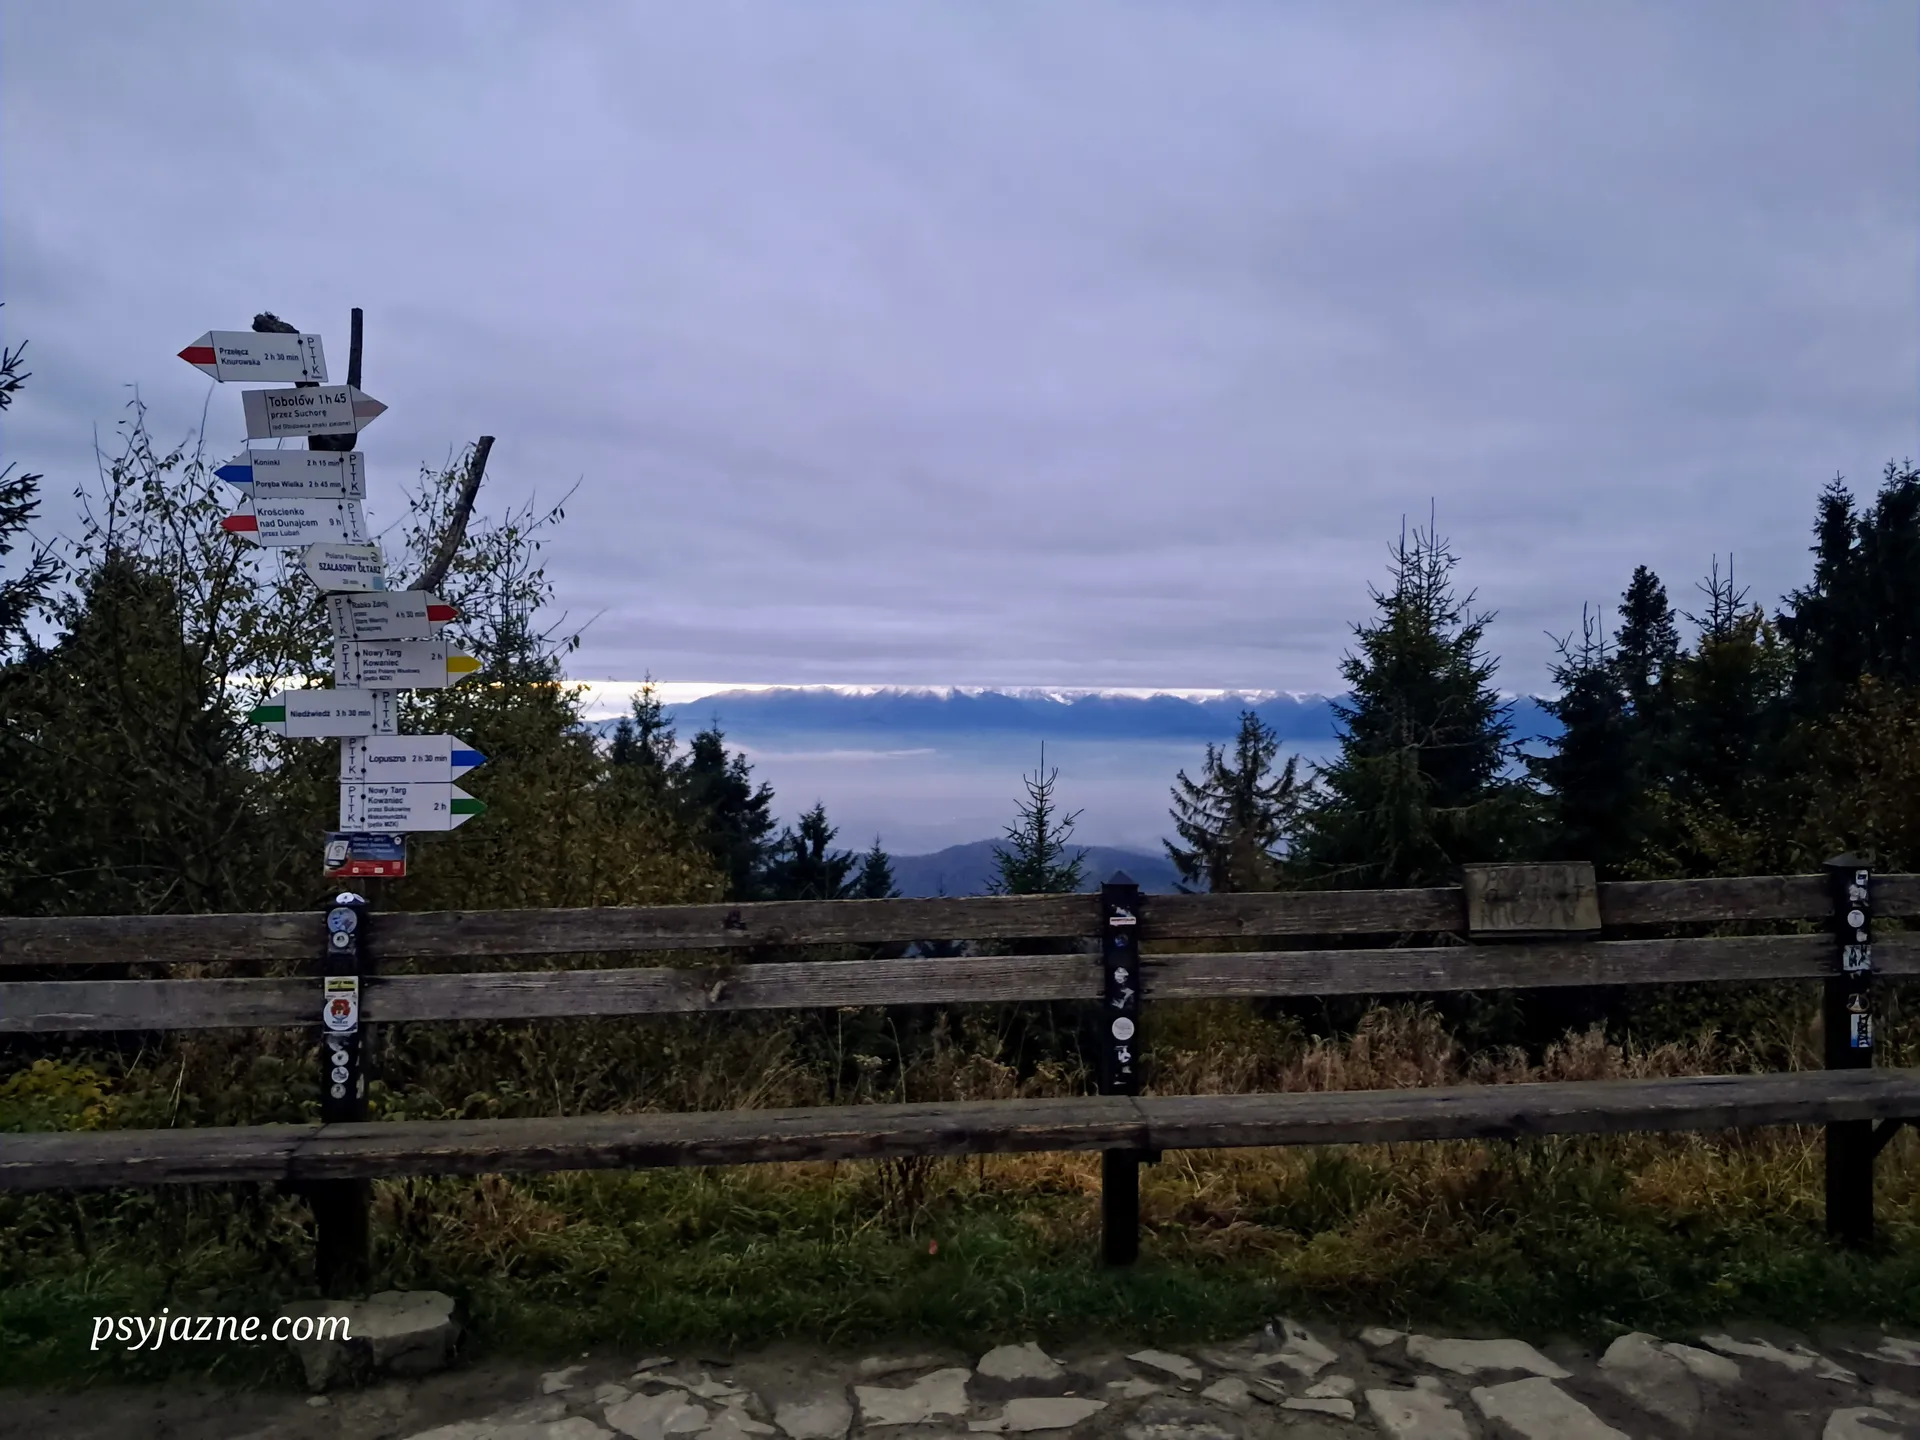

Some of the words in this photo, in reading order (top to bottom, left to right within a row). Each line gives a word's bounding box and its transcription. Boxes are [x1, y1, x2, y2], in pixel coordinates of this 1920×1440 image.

[276, 353, 285, 361] 30
[221, 358, 261, 366] Knurowska
[334, 393, 347, 404] 45
[271, 411, 292, 419] przez
[255, 481, 280, 489] Poręba
[257, 508, 305, 516] Krościenko
[259, 519, 275, 528] nad
[277, 519, 319, 528] Dunajcem
[329, 518, 334, 526] 9
[336, 518, 341, 526] h
[261, 530, 278, 538] przez
[362, 649, 383, 658] Nowy
[385, 649, 402, 658] Targ
[363, 659, 399, 667] Kowaniec
[368, 786, 388, 795] Nowy
[390, 786, 407, 795] Targ
